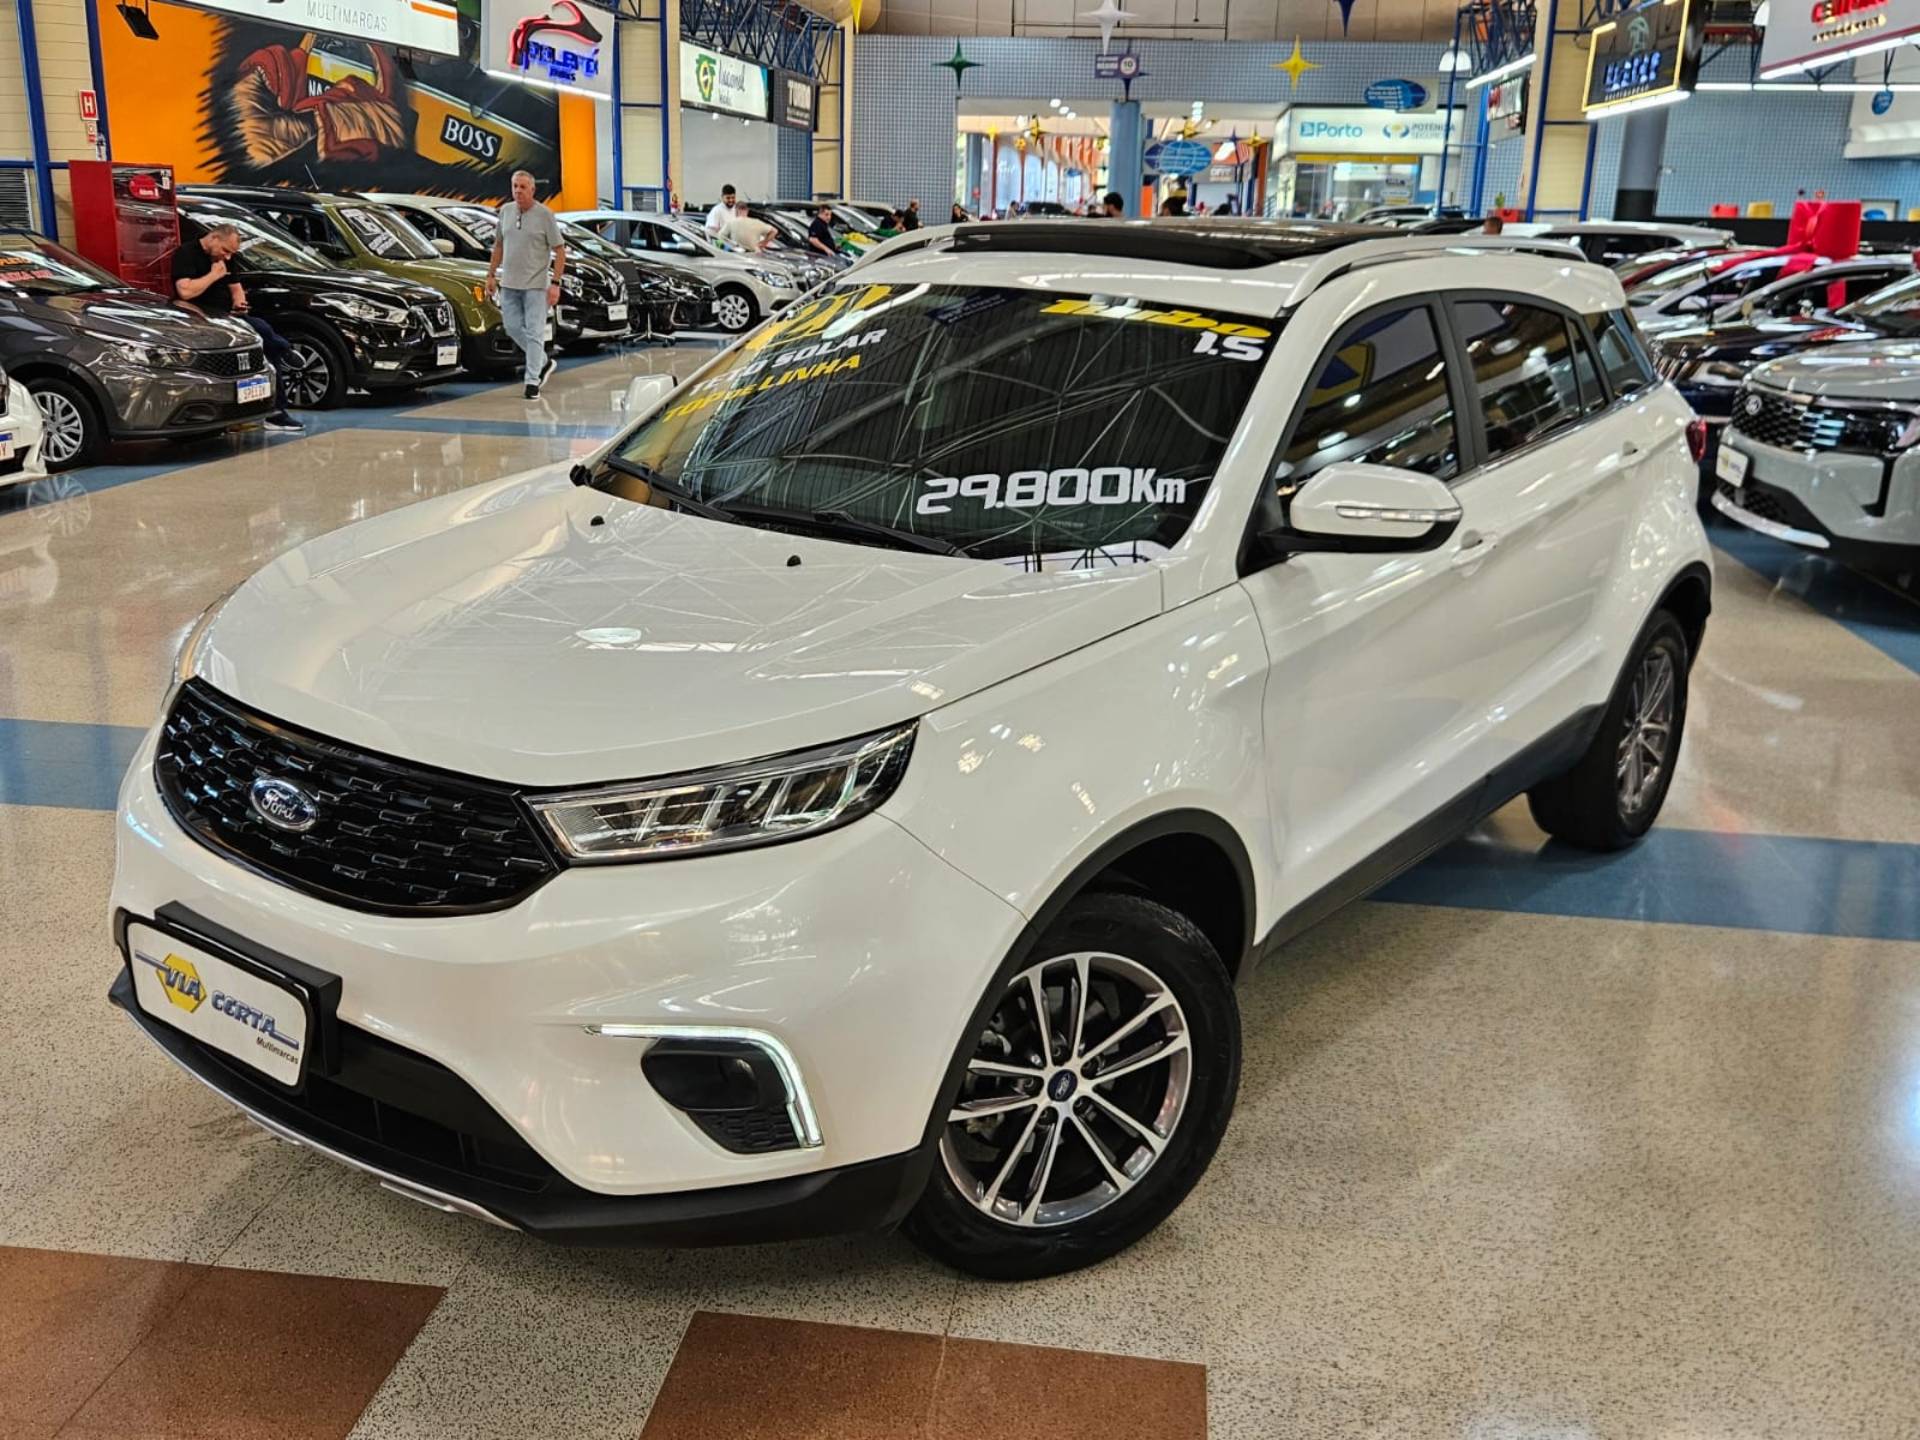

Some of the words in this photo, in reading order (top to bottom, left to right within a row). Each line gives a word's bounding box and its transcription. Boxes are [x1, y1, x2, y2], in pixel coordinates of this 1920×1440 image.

[306, 2, 388, 33] MULTIMARCAS
[84, 96, 94, 114] H
[444, 117, 498, 158] BOSS
[1316, 121, 1363, 138] Porto
[772, 328, 888, 369] SOLAR
[1193, 331, 1266, 361] 1.5
[662, 390, 726, 423] TOP
[758, 353, 861, 391] LINHA
[916, 466, 1186, 515] 29.800Km
[261, 788, 298, 820] Ford
[166, 967, 201, 1001] VIA
[211, 989, 276, 1035] CERTA
[256, 1035, 299, 1065] Multimarcas
